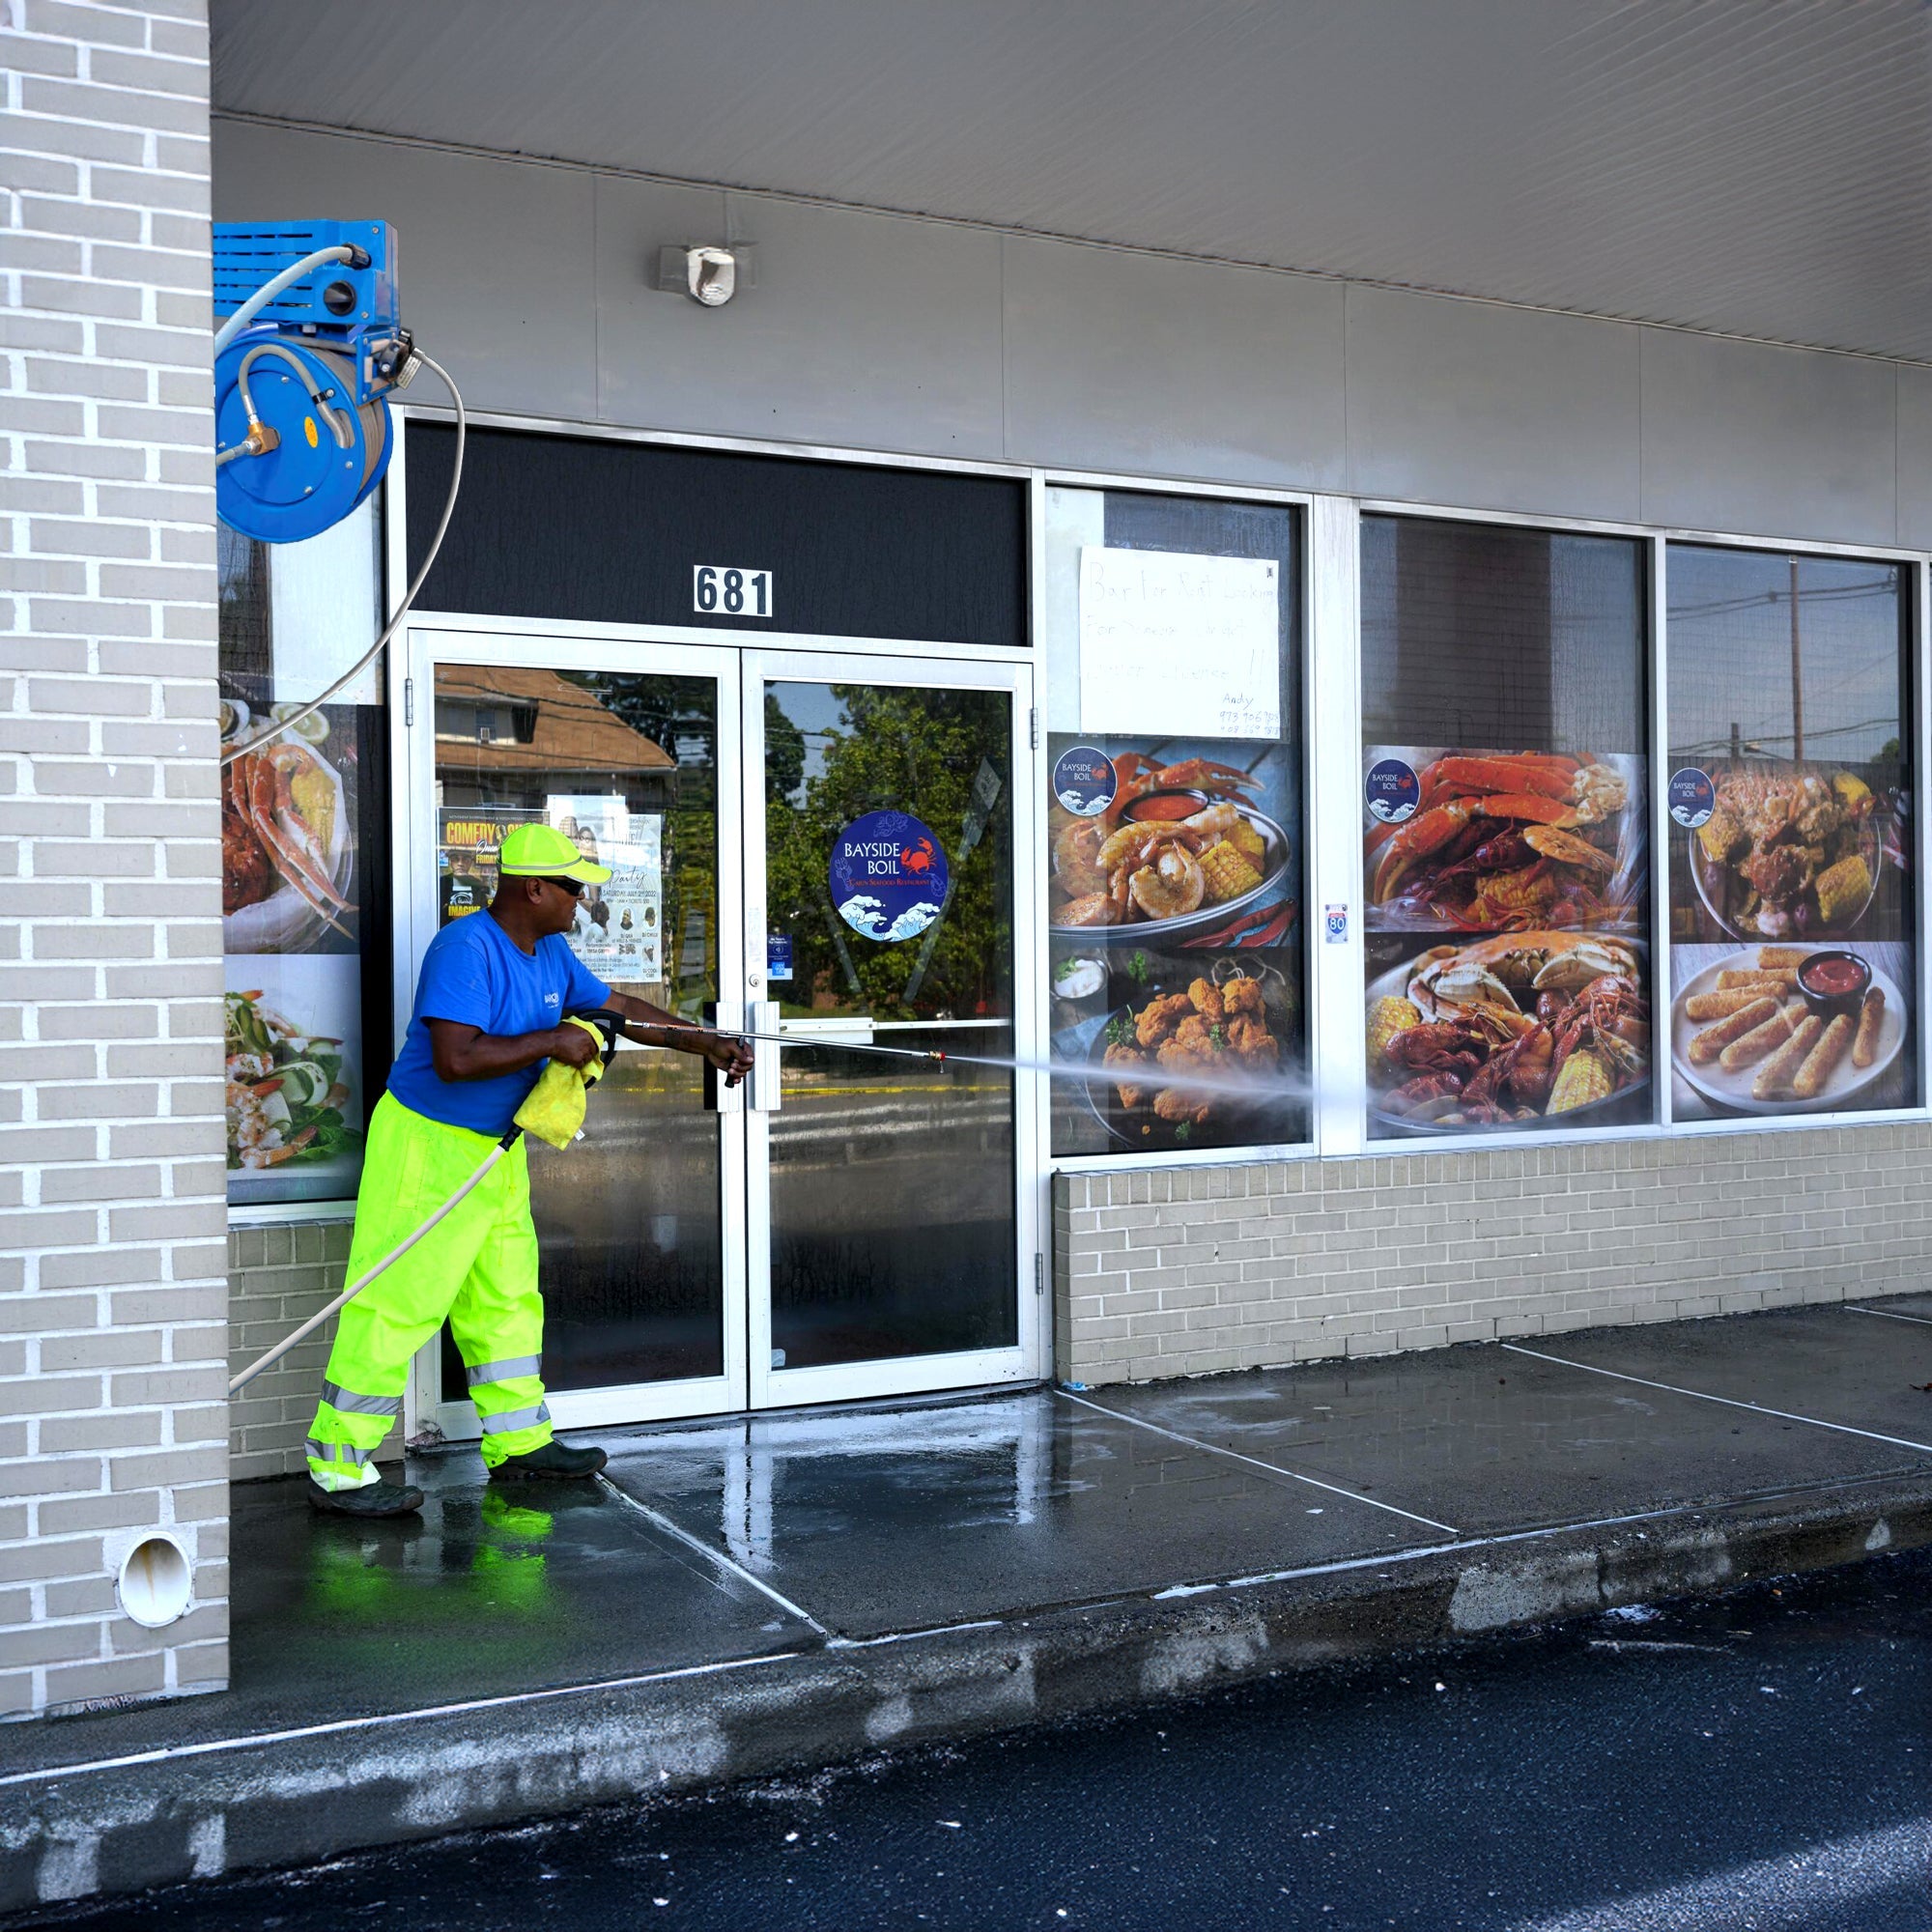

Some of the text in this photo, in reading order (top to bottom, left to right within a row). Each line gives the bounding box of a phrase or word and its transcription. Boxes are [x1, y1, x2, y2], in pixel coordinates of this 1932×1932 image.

[696, 567, 767, 615] 681
[1222, 692, 1254, 711] Andy
[1062, 763, 1092, 772] BAYSIDE
[446, 821, 497, 845] COMEDY
[844, 842, 901, 858] BAYSIDE
[867, 860, 900, 875] BOIL
[1329, 918, 1345, 930] 80
